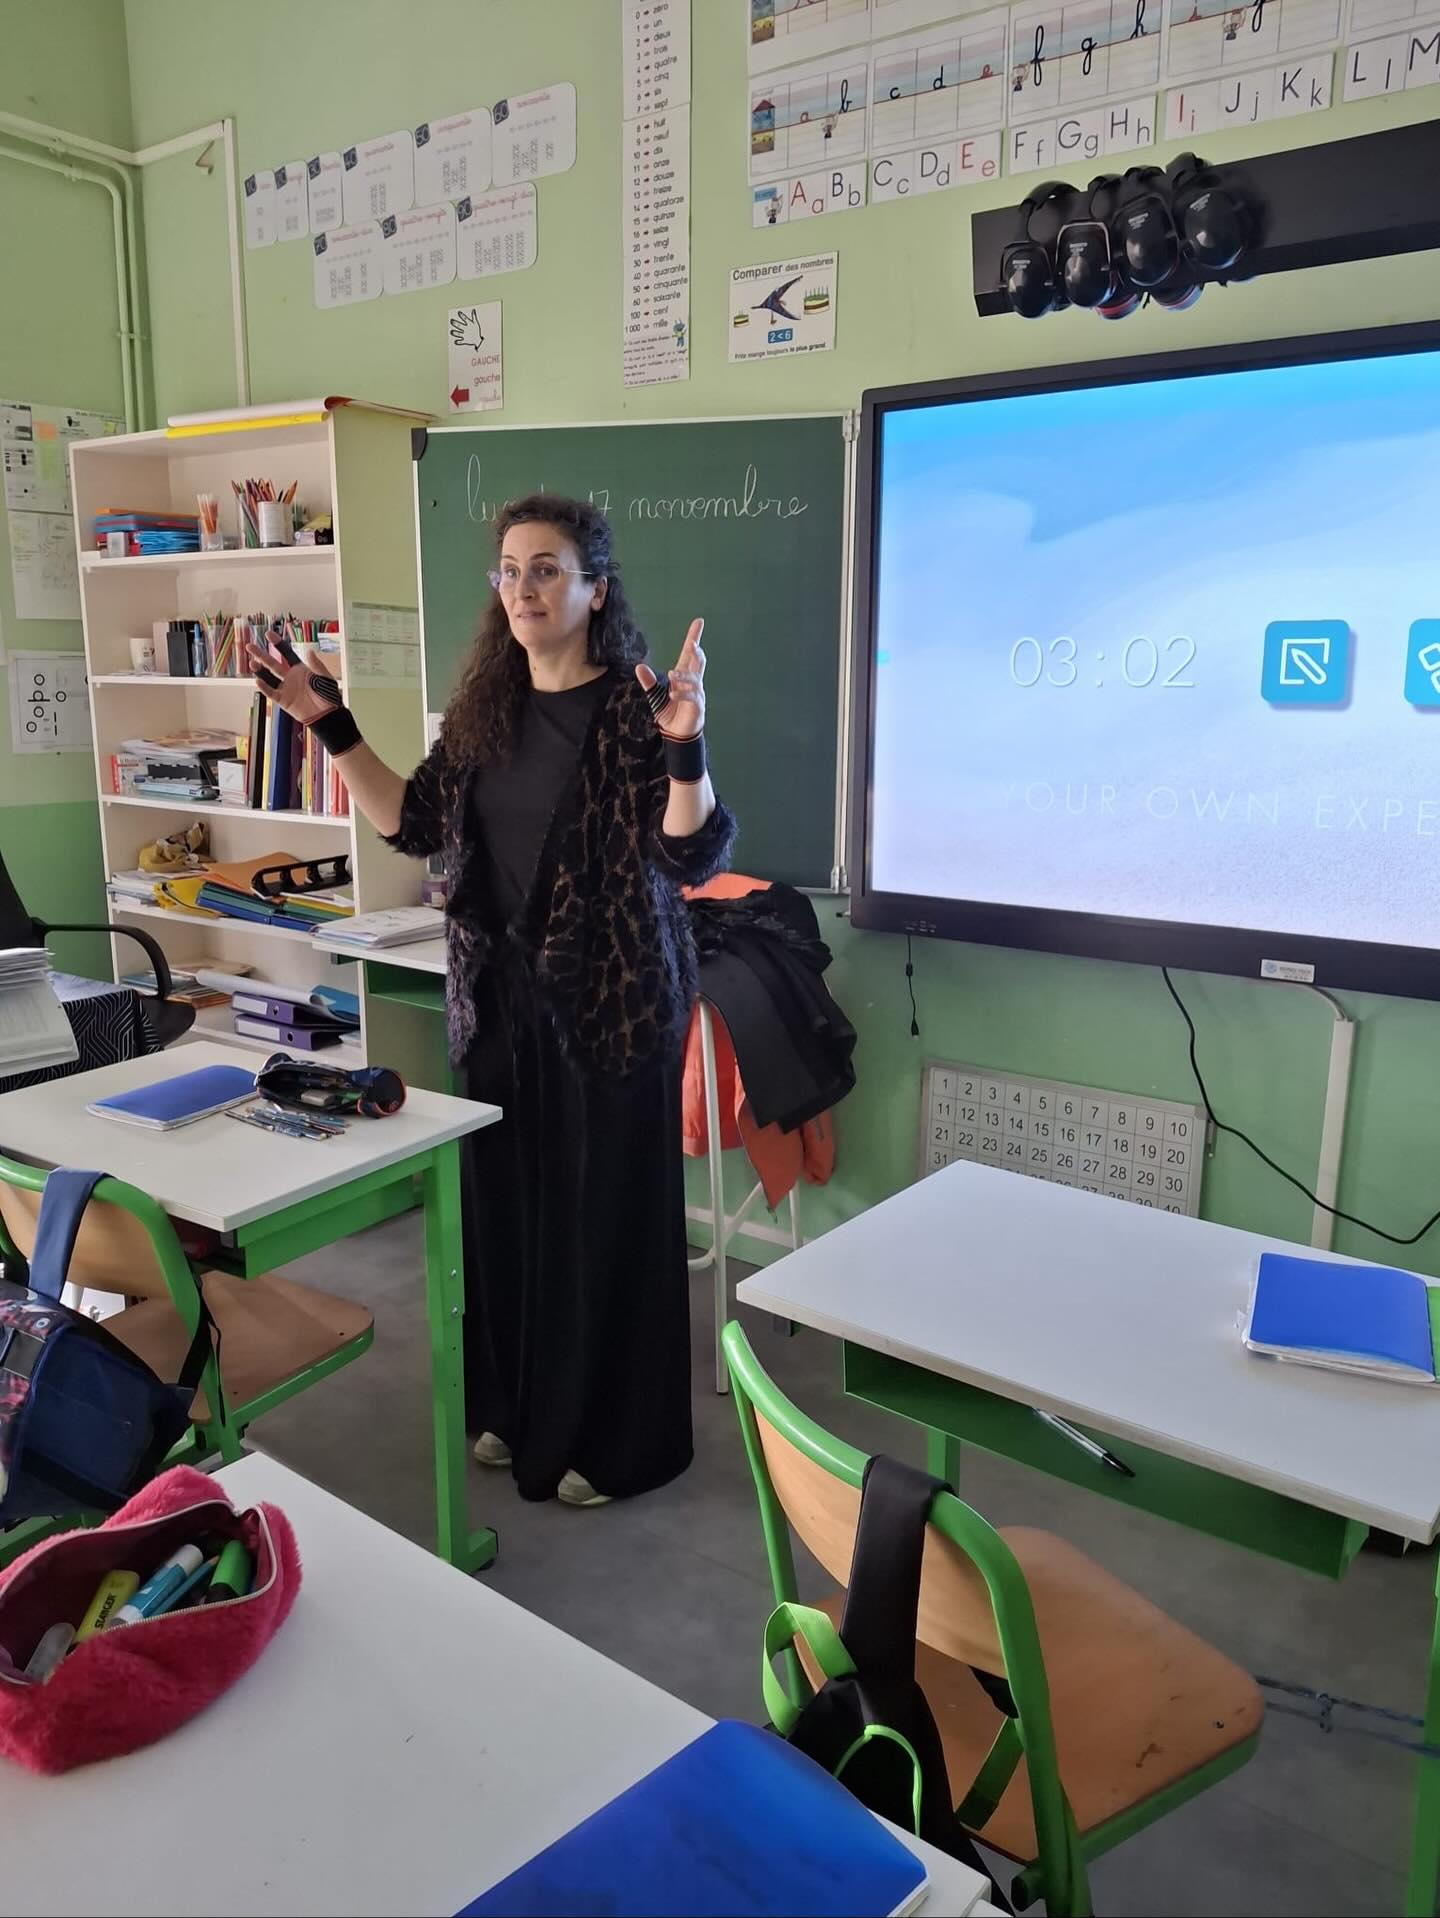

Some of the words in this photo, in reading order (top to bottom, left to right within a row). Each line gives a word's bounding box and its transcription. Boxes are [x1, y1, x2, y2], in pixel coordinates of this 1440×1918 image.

[1031, 25, 1044, 86] f
[1081, 38, 1097, 75] g
[1130, 0, 1148, 40] h
[800, 111, 811, 123] a
[839, 80, 851, 113] b
[889, 88, 901, 100] c
[933, 65, 946, 90] d
[980, 64, 993, 78] e
[733, 264, 782, 281] Comparer
[785, 264, 798, 272] des
[801, 258, 834, 268] nombres
[471, 354, 500, 367] GAUCHE
[474, 374, 500, 384] gauche
[629, 464, 808, 521] novembre
[1146, 785, 1280, 824] OWN
[942, 1078, 948, 1089] 1
[964, 1082, 974, 1096] 2
[989, 1087, 997, 1100] 3
[1013, 1092, 1021, 1104] 4
[1039, 1096, 1047, 1110] 5
[1064, 1102, 1073, 1115] 6
[1092, 1106, 1100, 1120] 7
[1118, 1112, 1126, 1124] 8
[1145, 1117, 1154, 1130] 9
[1171, 1122, 1187, 1137] 10
[937, 1104, 950, 1116] 11
[962, 1108, 975, 1121] 12
[985, 1112, 999, 1126] 13
[1010, 1117, 1024, 1131] 14
[1034, 1122, 1049, 1136] 15
[1060, 1128, 1075, 1142] 16
[1086, 1132, 1102, 1146] 17
[1113, 1138, 1128, 1152] 18
[1140, 1144, 1157, 1158] 19
[1167, 1149, 1185, 1164] 20
[934, 1152, 948, 1165] 31
[935, 1128, 949, 1141] 21
[958, 1132, 973, 1146] 22
[982, 1137, 998, 1152] 23
[1007, 1142, 1022, 1156] 24
[1031, 1148, 1048, 1162] 25
[1057, 1153, 1073, 1168] 26
[1082, 1159, 1100, 1174] 27
[1110, 1164, 1126, 1180] 28
[1136, 1170, 1155, 1186] 29
[1165, 1176, 1183, 1192] 30
